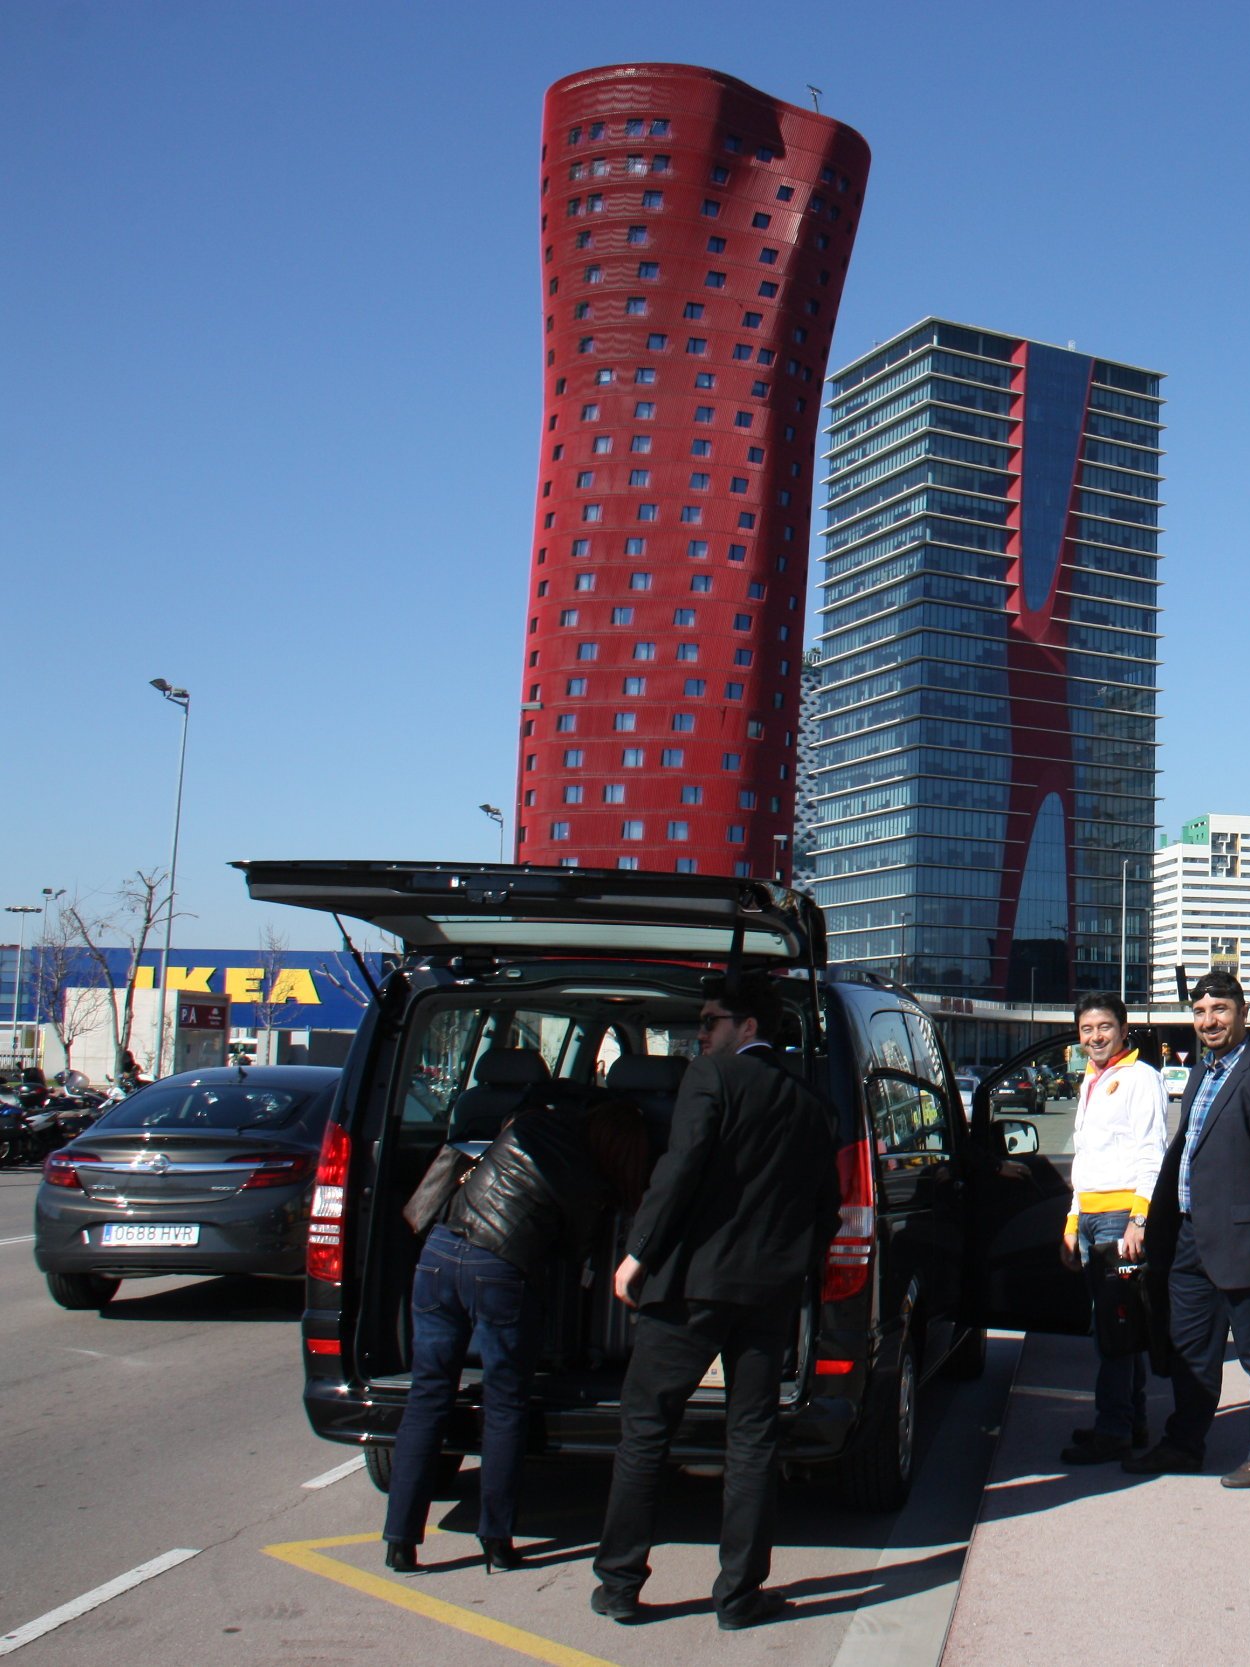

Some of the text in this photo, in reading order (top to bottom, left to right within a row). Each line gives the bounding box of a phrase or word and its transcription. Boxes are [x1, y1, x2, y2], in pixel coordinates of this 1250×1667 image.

[134, 966, 322, 1004] IKEA
[115, 1225, 193, 1241] 0688 HVR
